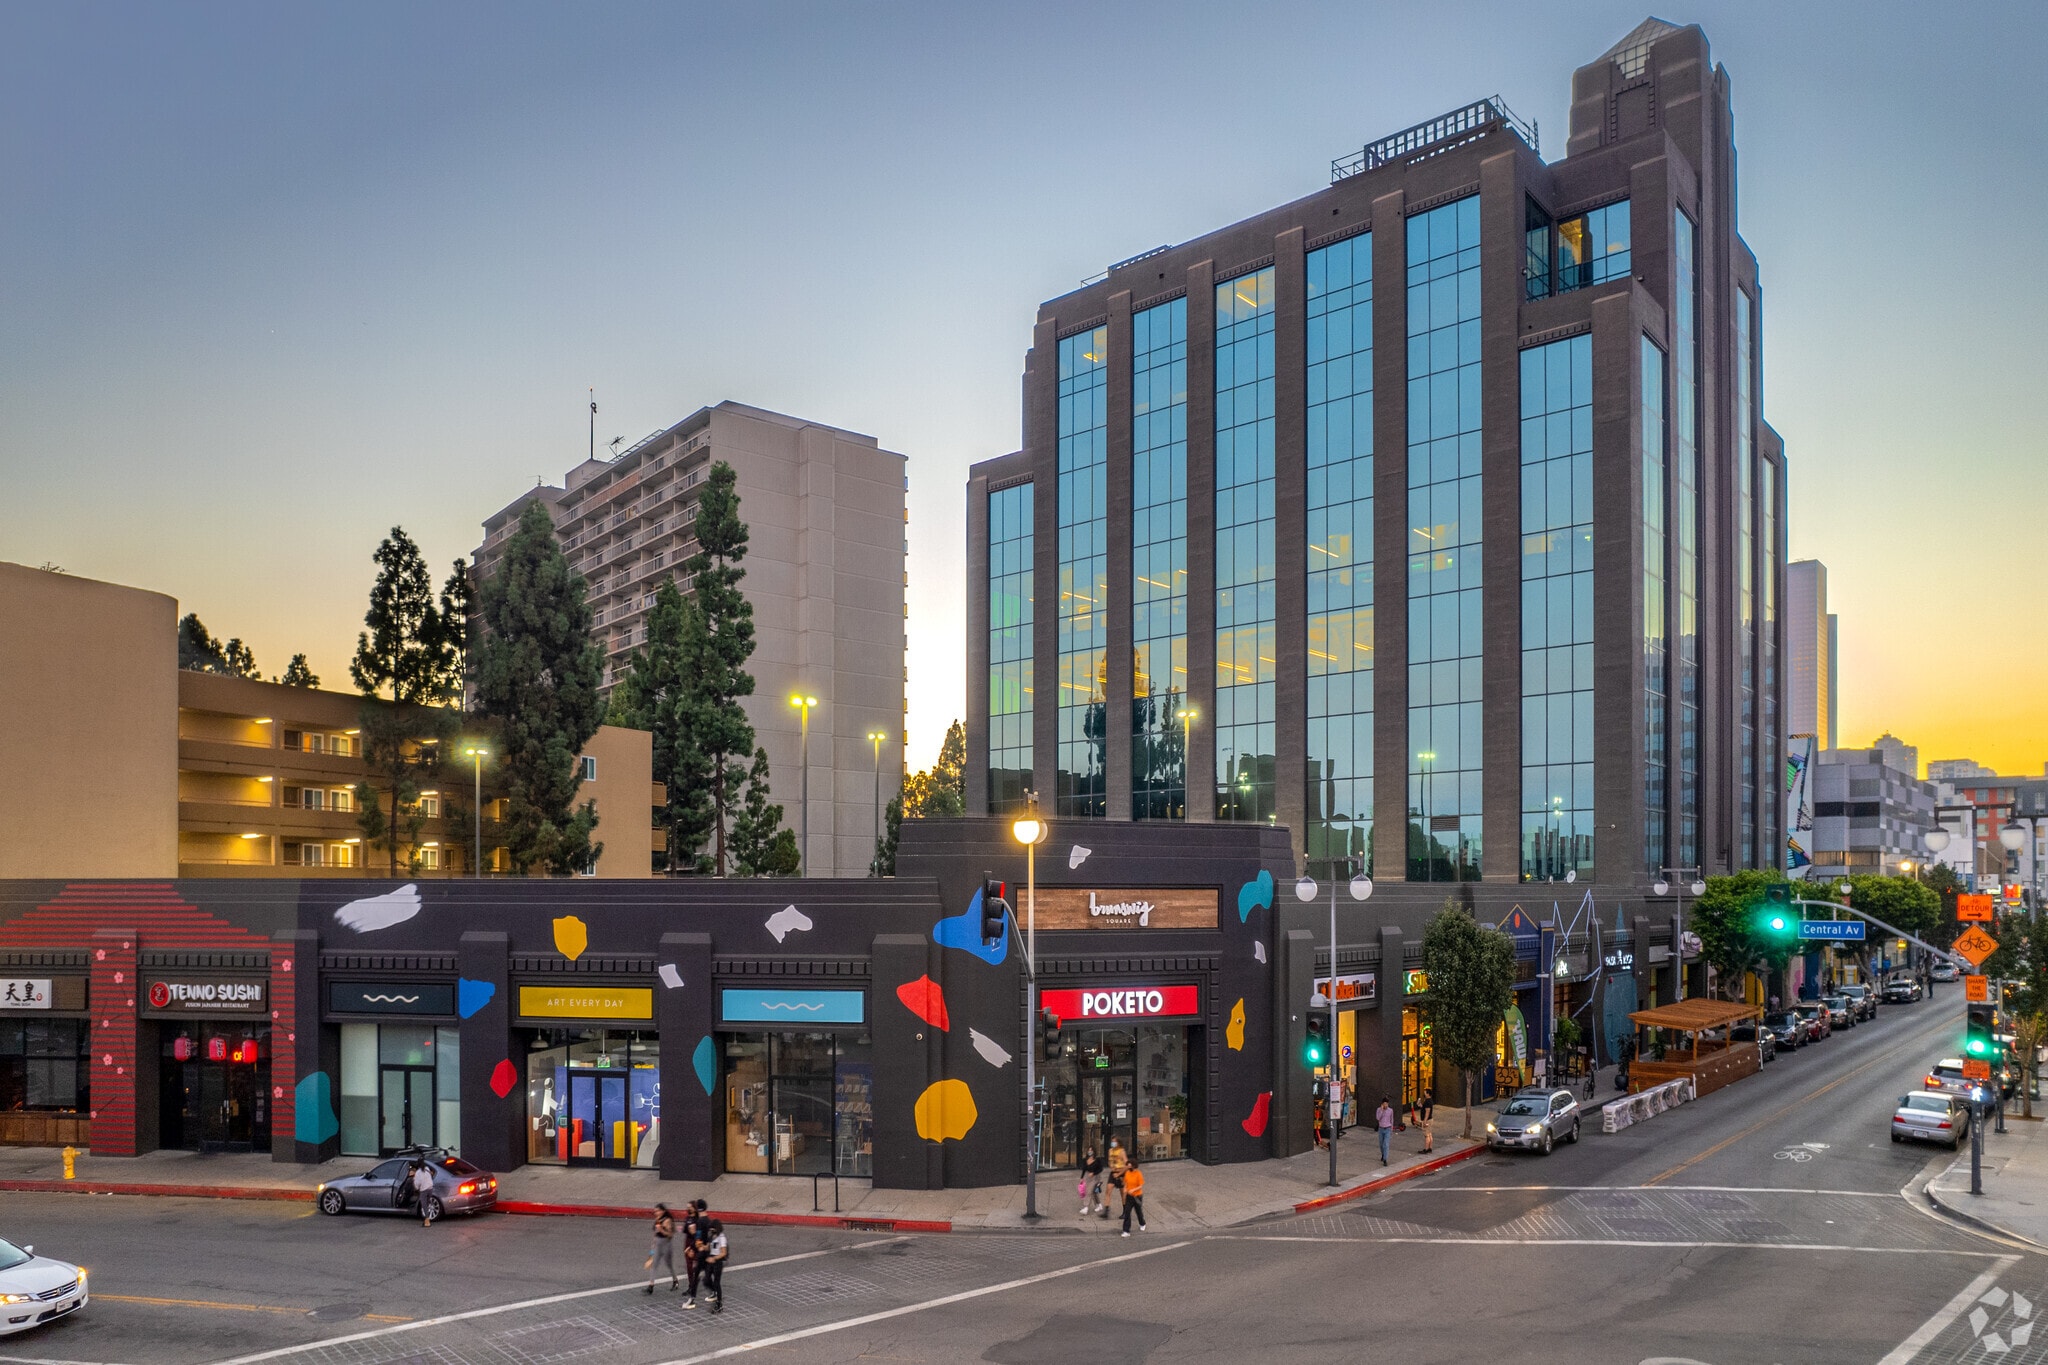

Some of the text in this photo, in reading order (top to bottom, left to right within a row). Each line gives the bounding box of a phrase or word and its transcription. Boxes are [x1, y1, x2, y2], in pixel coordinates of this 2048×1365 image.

[1089, 892, 1155, 927] brunswig
[1960, 904, 1990, 912] DETOUR
[1803, 924, 1860, 935] Central Av
[5, 980, 36, 1002] 天皇
[169, 983, 216, 1001] TENNO
[217, 983, 262, 1001] SUSHI
[547, 998, 624, 1008] ART EVERY DAY
[1082, 990, 1164, 1016] POKETO
